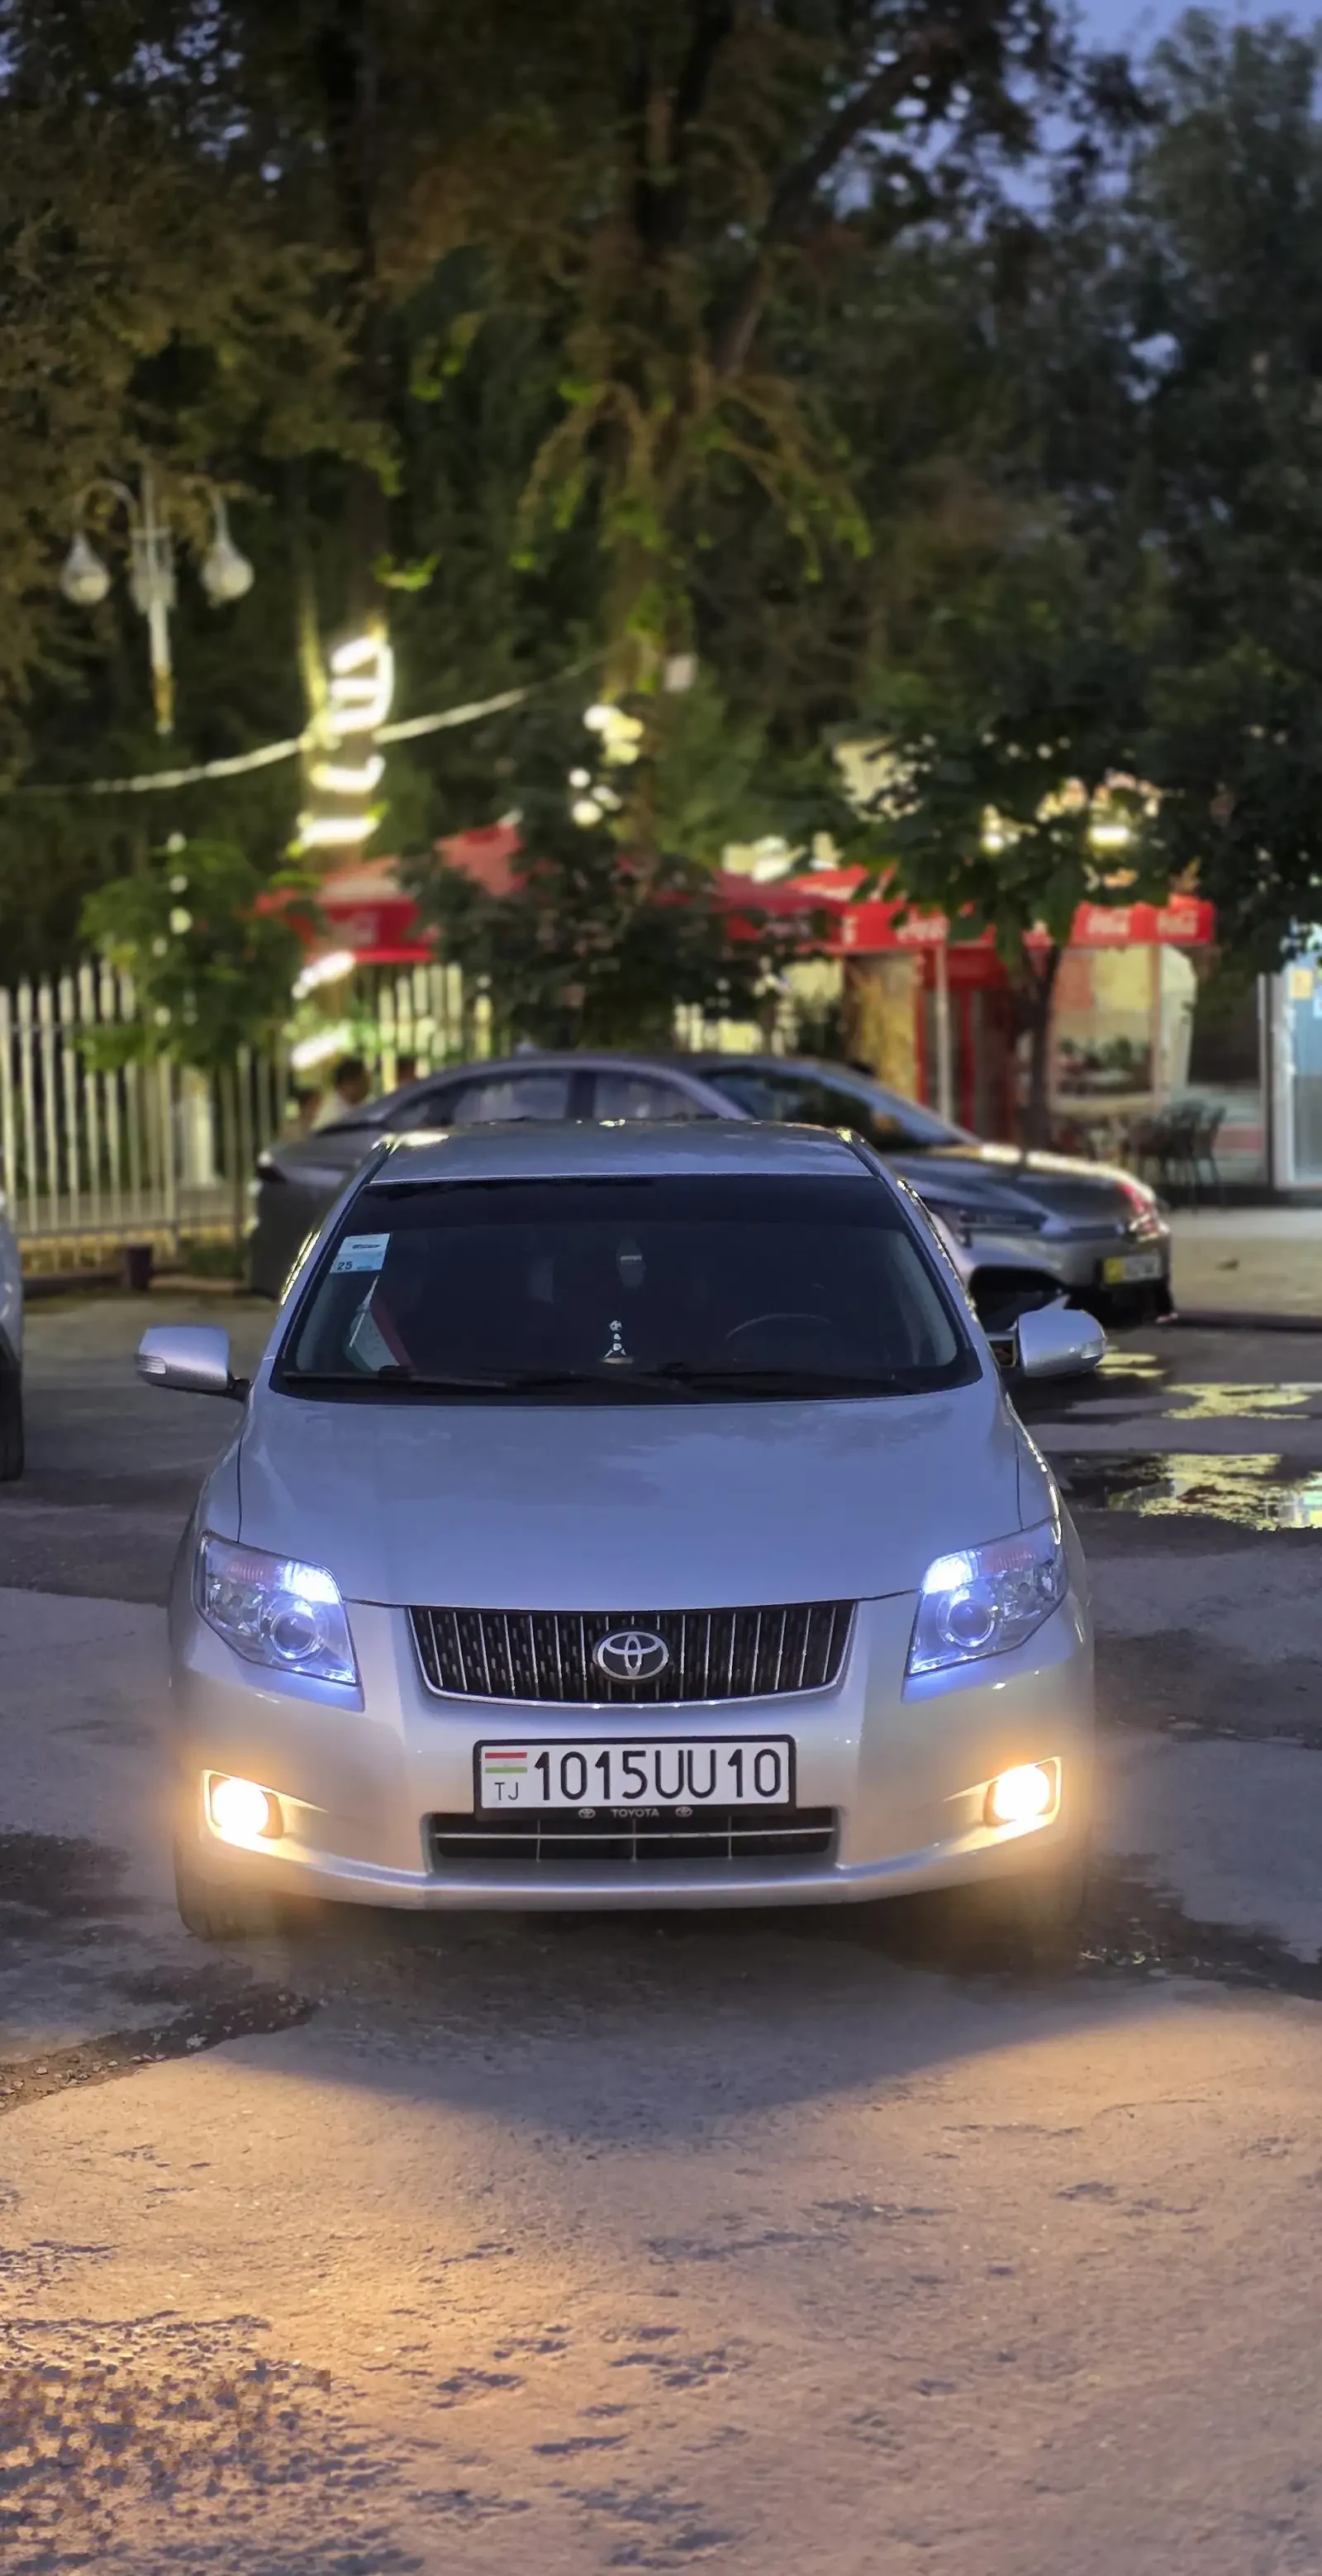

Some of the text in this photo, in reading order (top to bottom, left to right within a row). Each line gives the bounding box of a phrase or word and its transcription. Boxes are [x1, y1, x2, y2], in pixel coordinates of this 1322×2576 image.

[337, 1261, 353, 1270] 25
[534, 1749, 782, 1801] 1015UU10
[494, 1782, 519, 1801] TJ
[611, 1808, 659, 1817] TOYOTA
